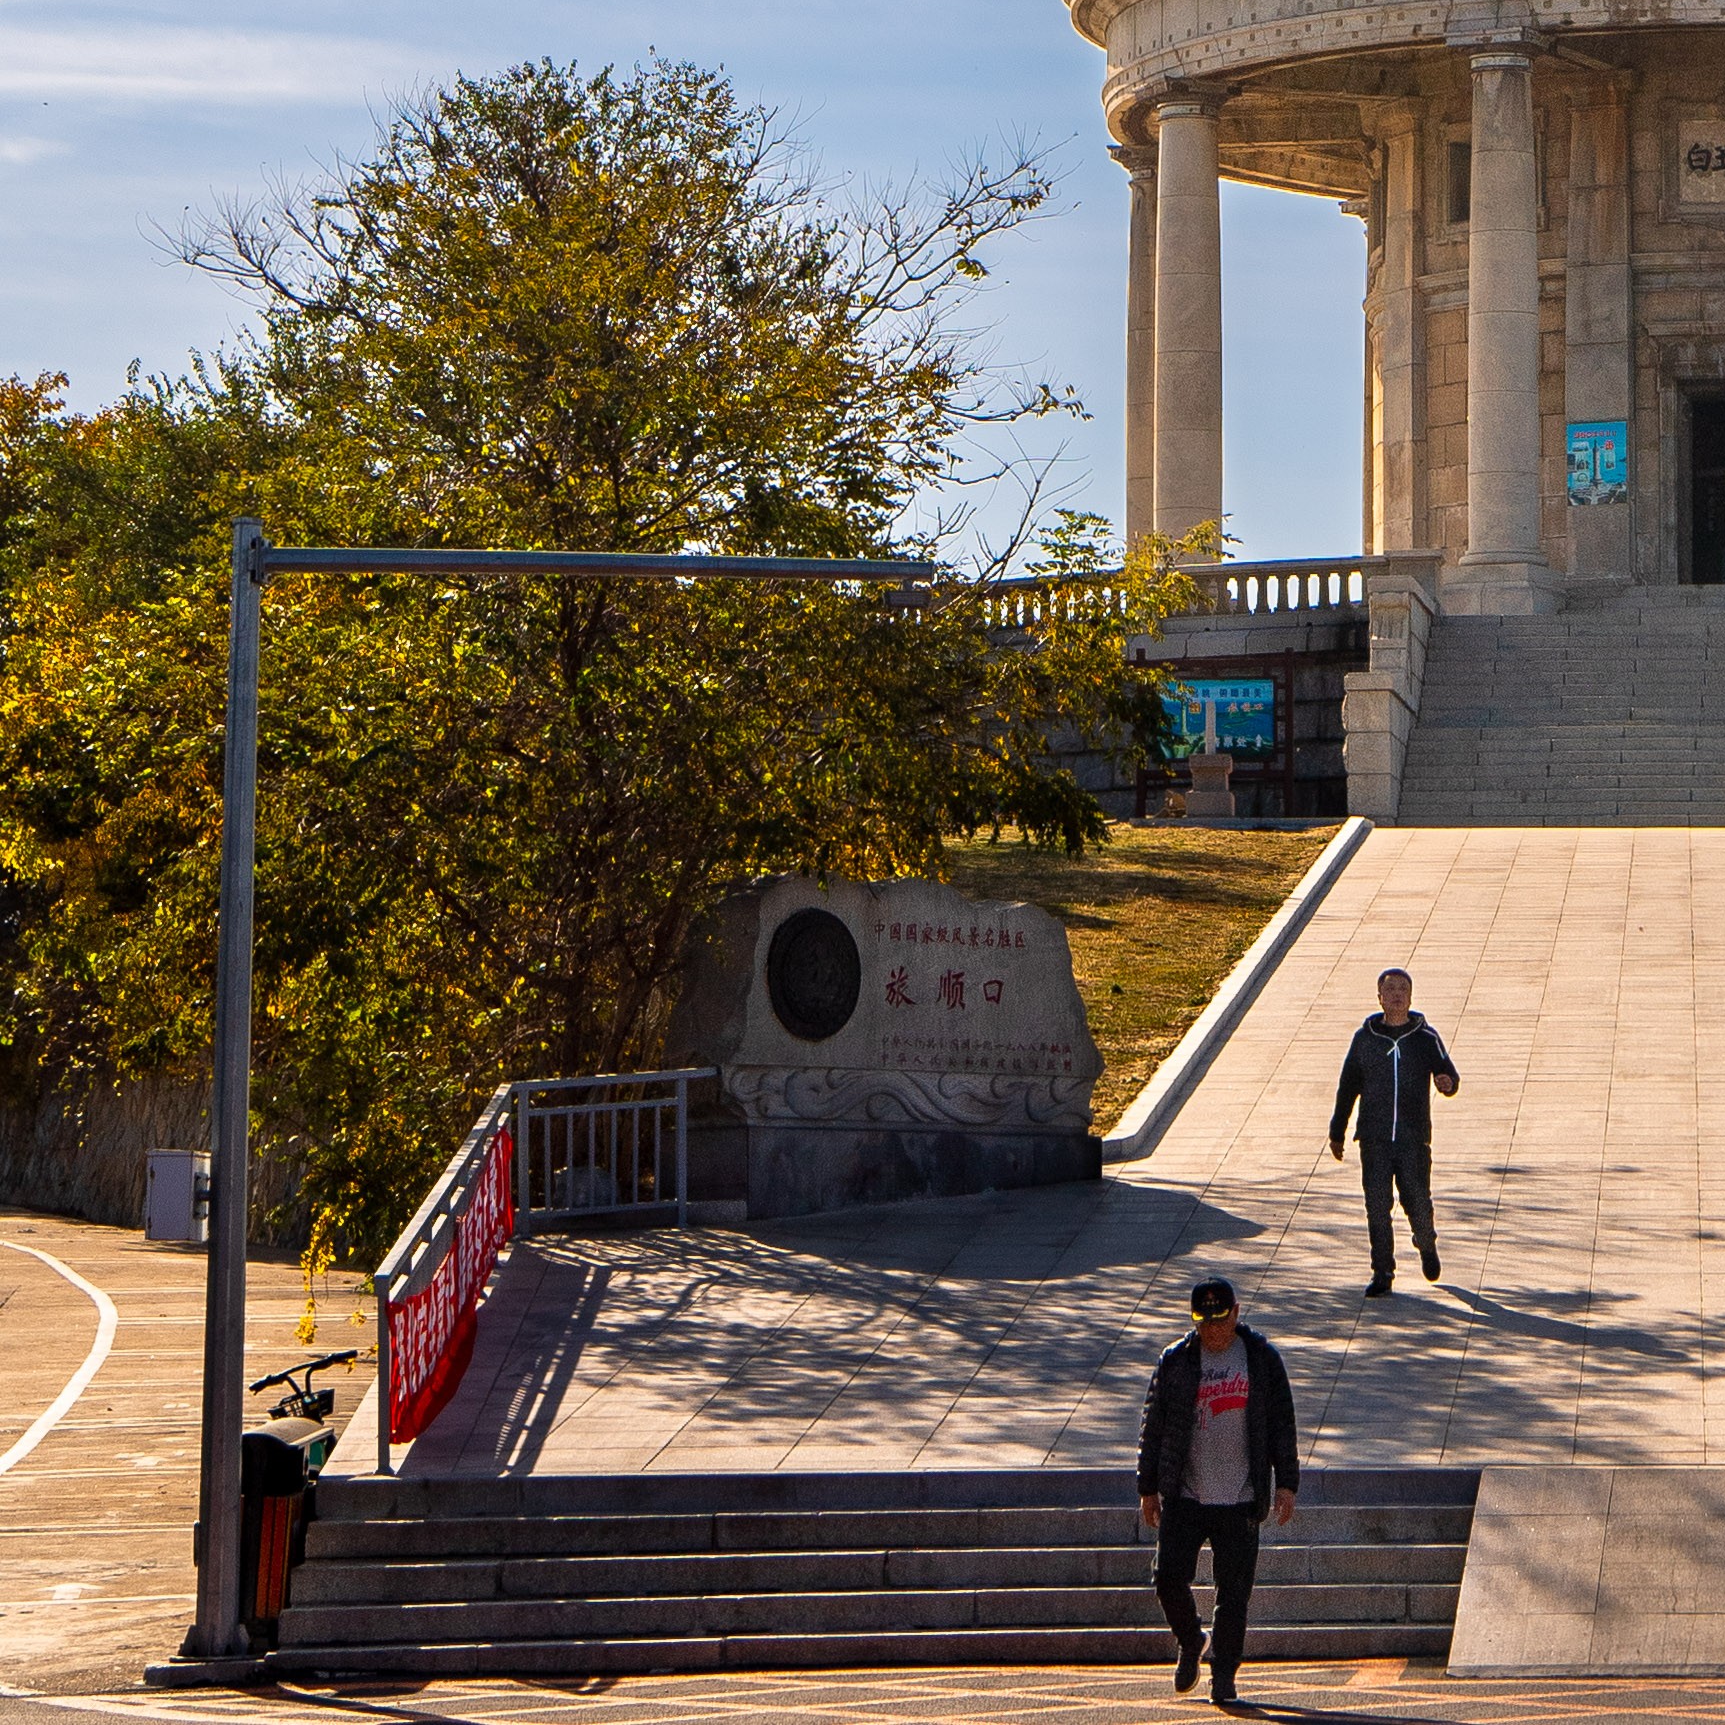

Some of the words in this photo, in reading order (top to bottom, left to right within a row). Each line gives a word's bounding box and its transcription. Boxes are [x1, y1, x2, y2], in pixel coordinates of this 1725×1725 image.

[874, 919, 1025, 948] 中国国家级风景名胜区
[885, 965, 1004, 1010] 旅顺口
